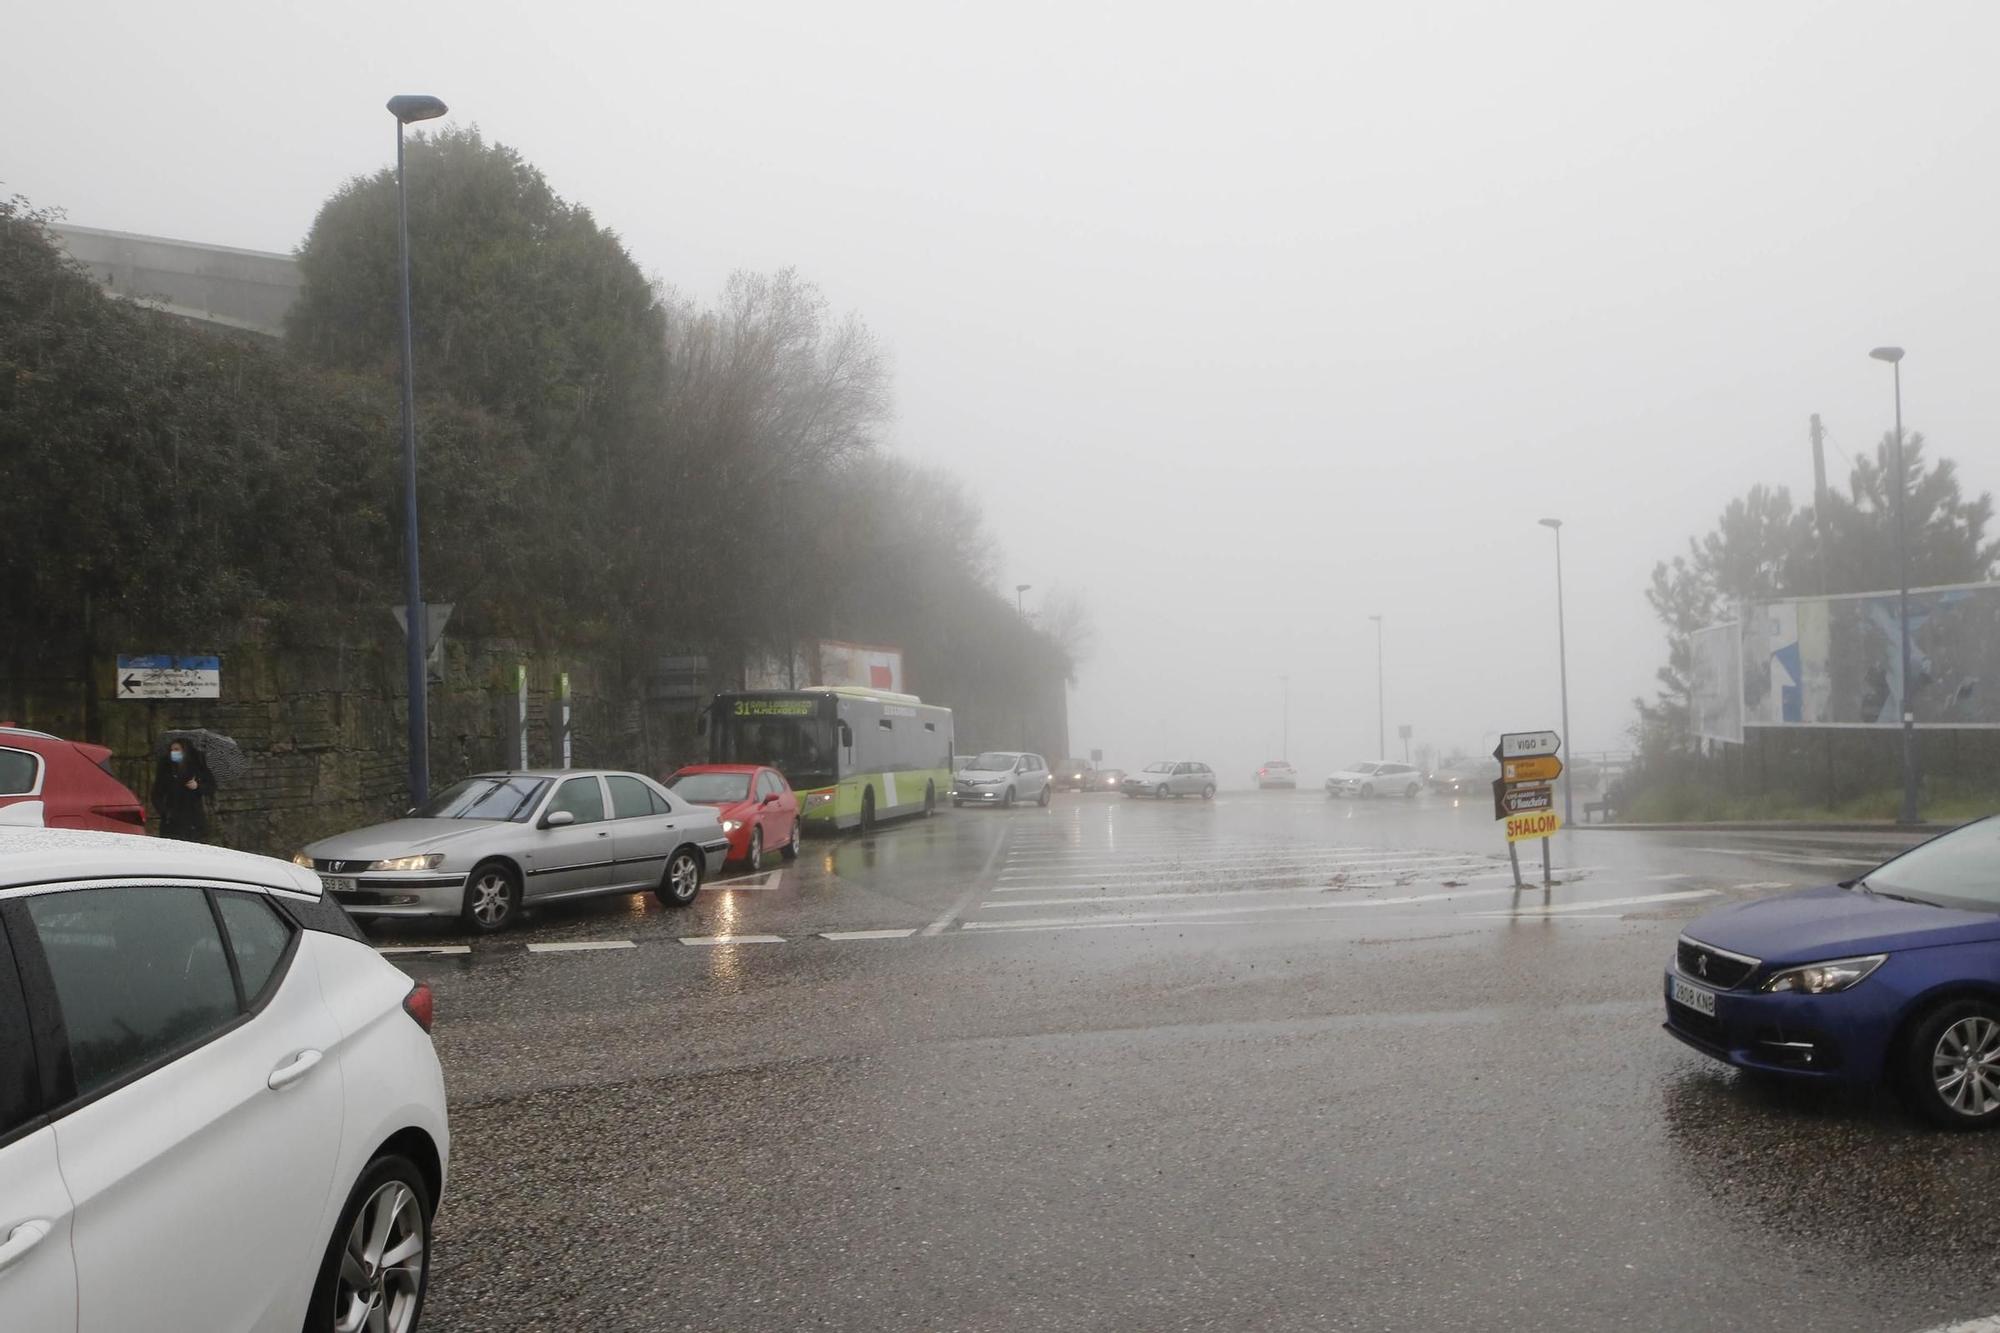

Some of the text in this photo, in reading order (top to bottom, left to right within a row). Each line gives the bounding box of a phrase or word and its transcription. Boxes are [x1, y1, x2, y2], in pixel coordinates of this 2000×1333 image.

[735, 700, 752, 715] 31
[1517, 739, 1537, 750] VIGO
[1507, 815, 1557, 837] SHALOM
